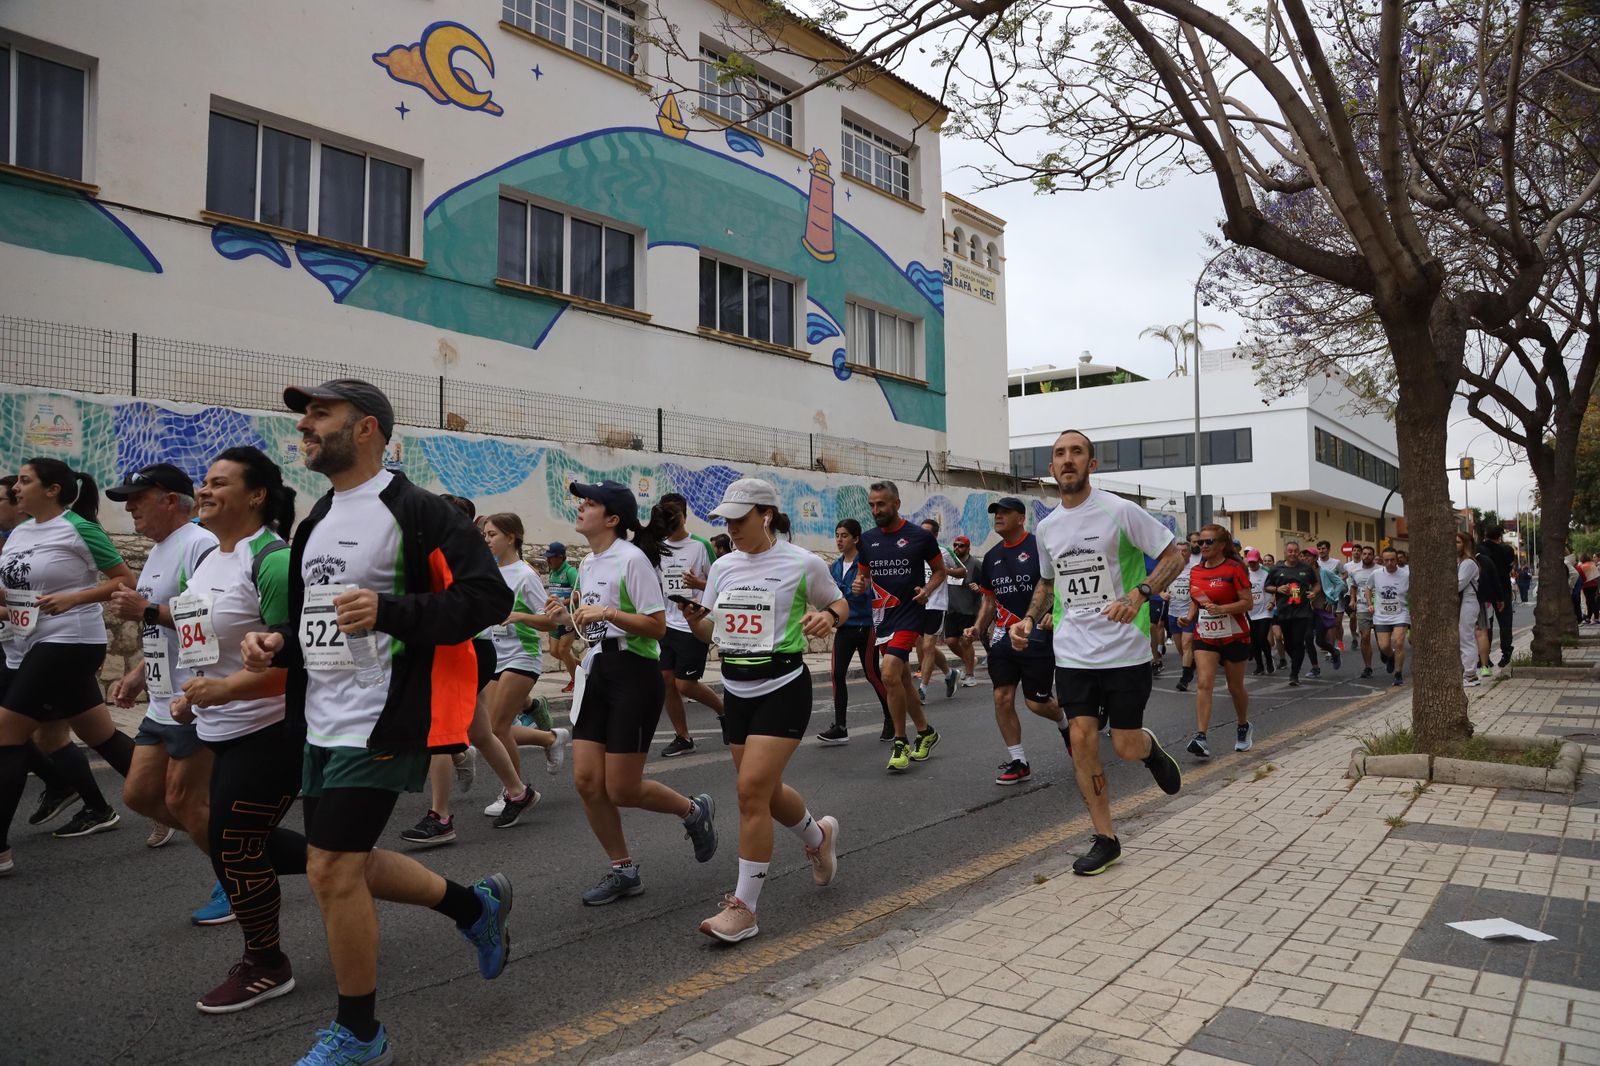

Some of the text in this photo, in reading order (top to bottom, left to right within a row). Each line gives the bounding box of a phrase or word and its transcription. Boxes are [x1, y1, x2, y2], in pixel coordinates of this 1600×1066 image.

[954, 277, 972, 293] SAFA
[979, 287, 994, 301] ICET
[869, 558, 910, 568] CERRADO
[870, 566, 912, 576] CALDERÓN
[991, 574, 1031, 587] CERRDO
[1068, 575, 1100, 595] 417
[305, 619, 344, 648] 522
[725, 613, 762, 634] 325
[1204, 620, 1225, 631] 301
[178, 622, 206, 648] 84
